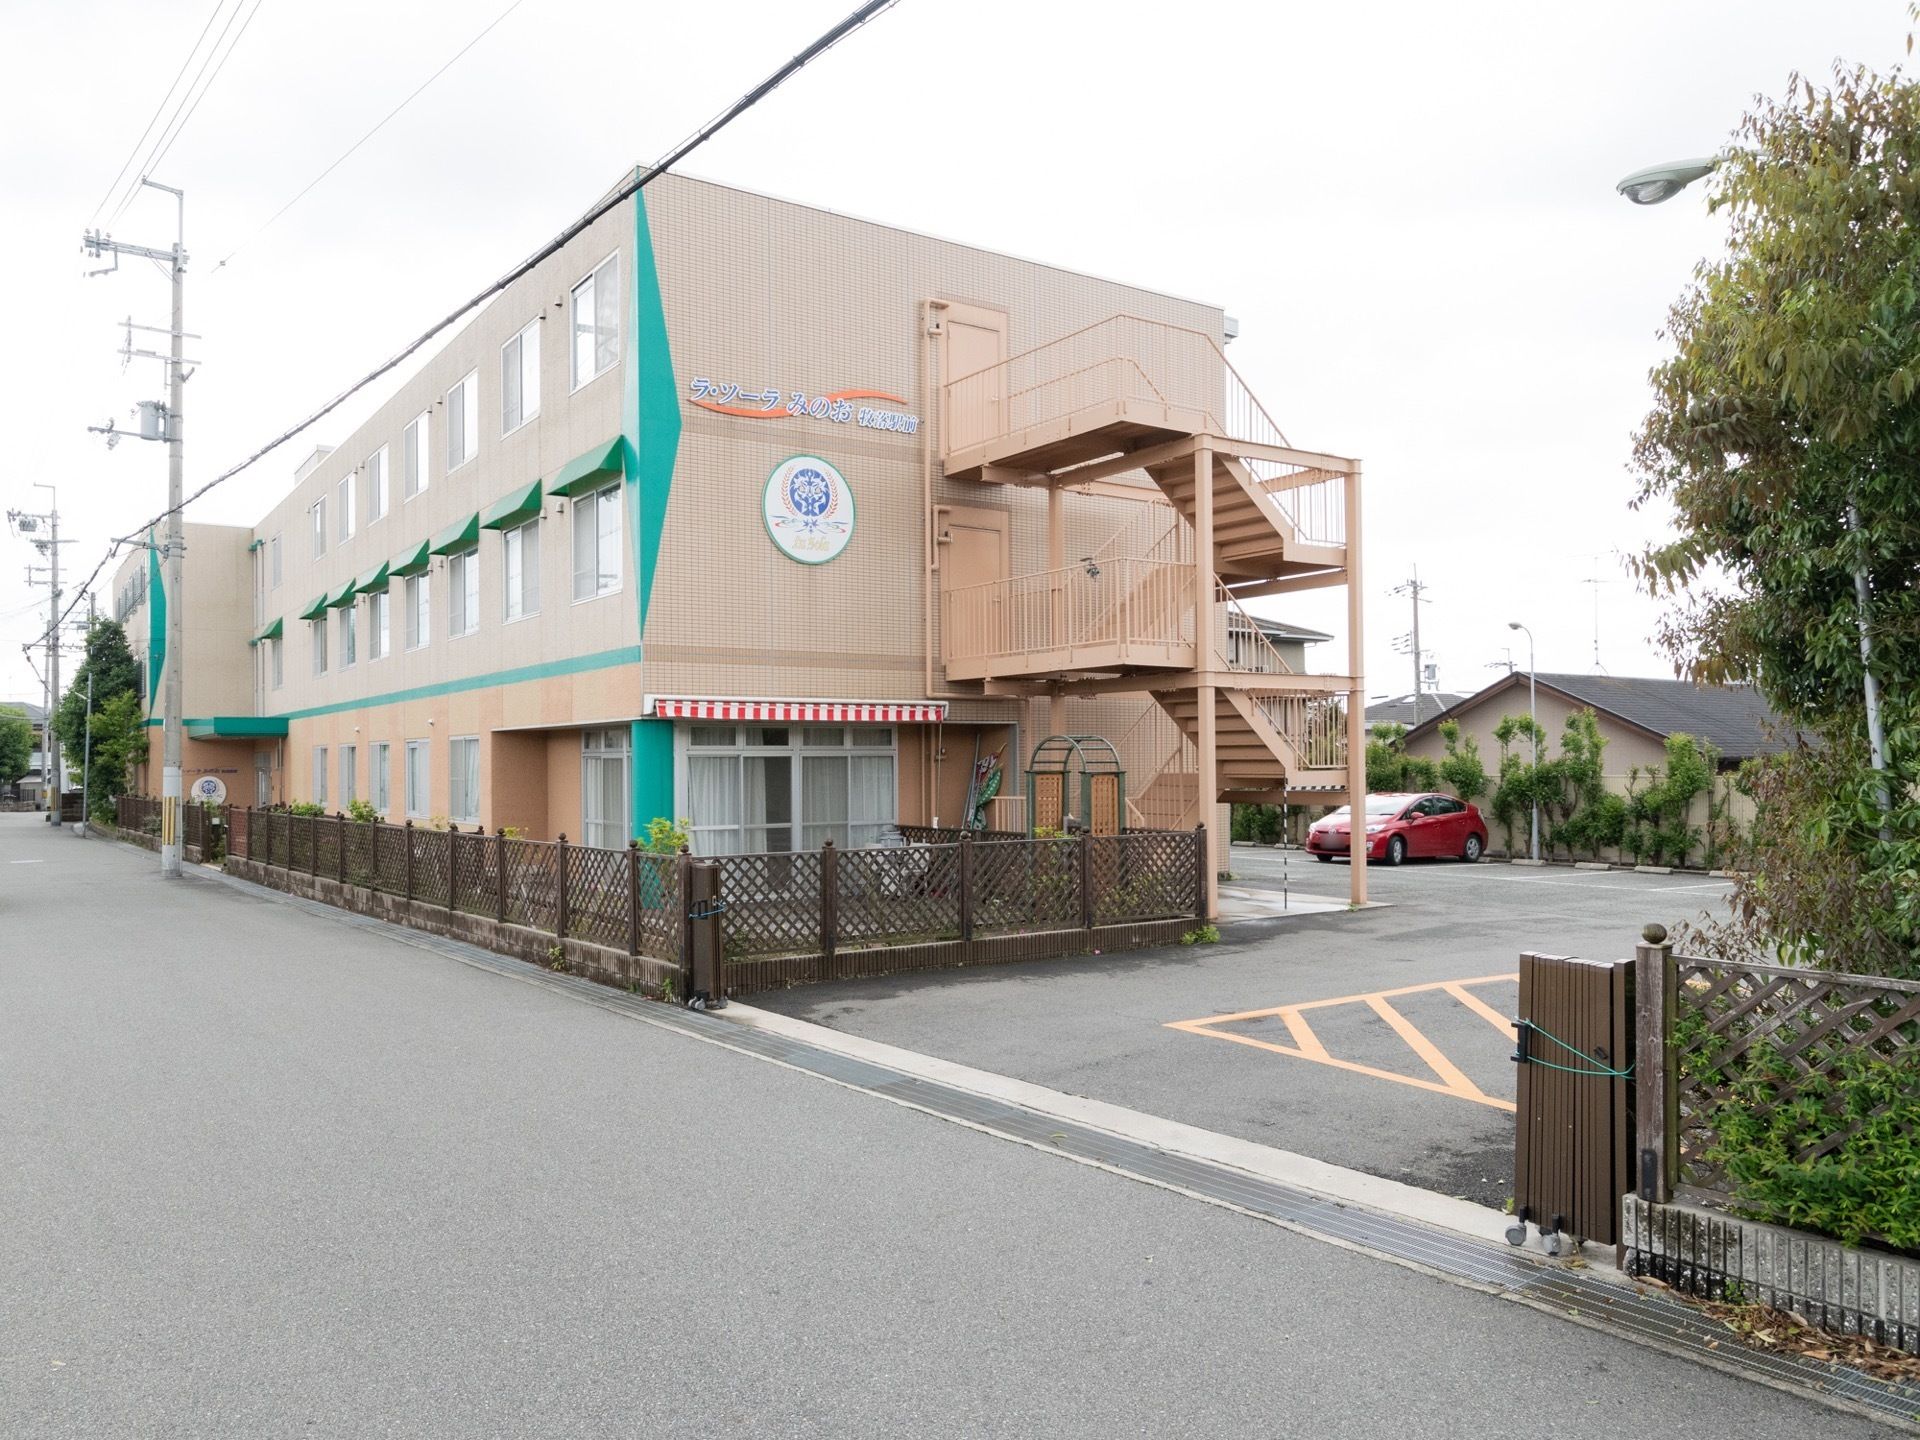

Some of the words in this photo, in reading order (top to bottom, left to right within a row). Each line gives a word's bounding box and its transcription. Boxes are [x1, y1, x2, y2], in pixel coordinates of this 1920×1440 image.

[691, 378, 780, 411] ラ・ソーラ
[787, 391, 853, 422] みのお
[858, 408, 918, 433] 牧落駅前
